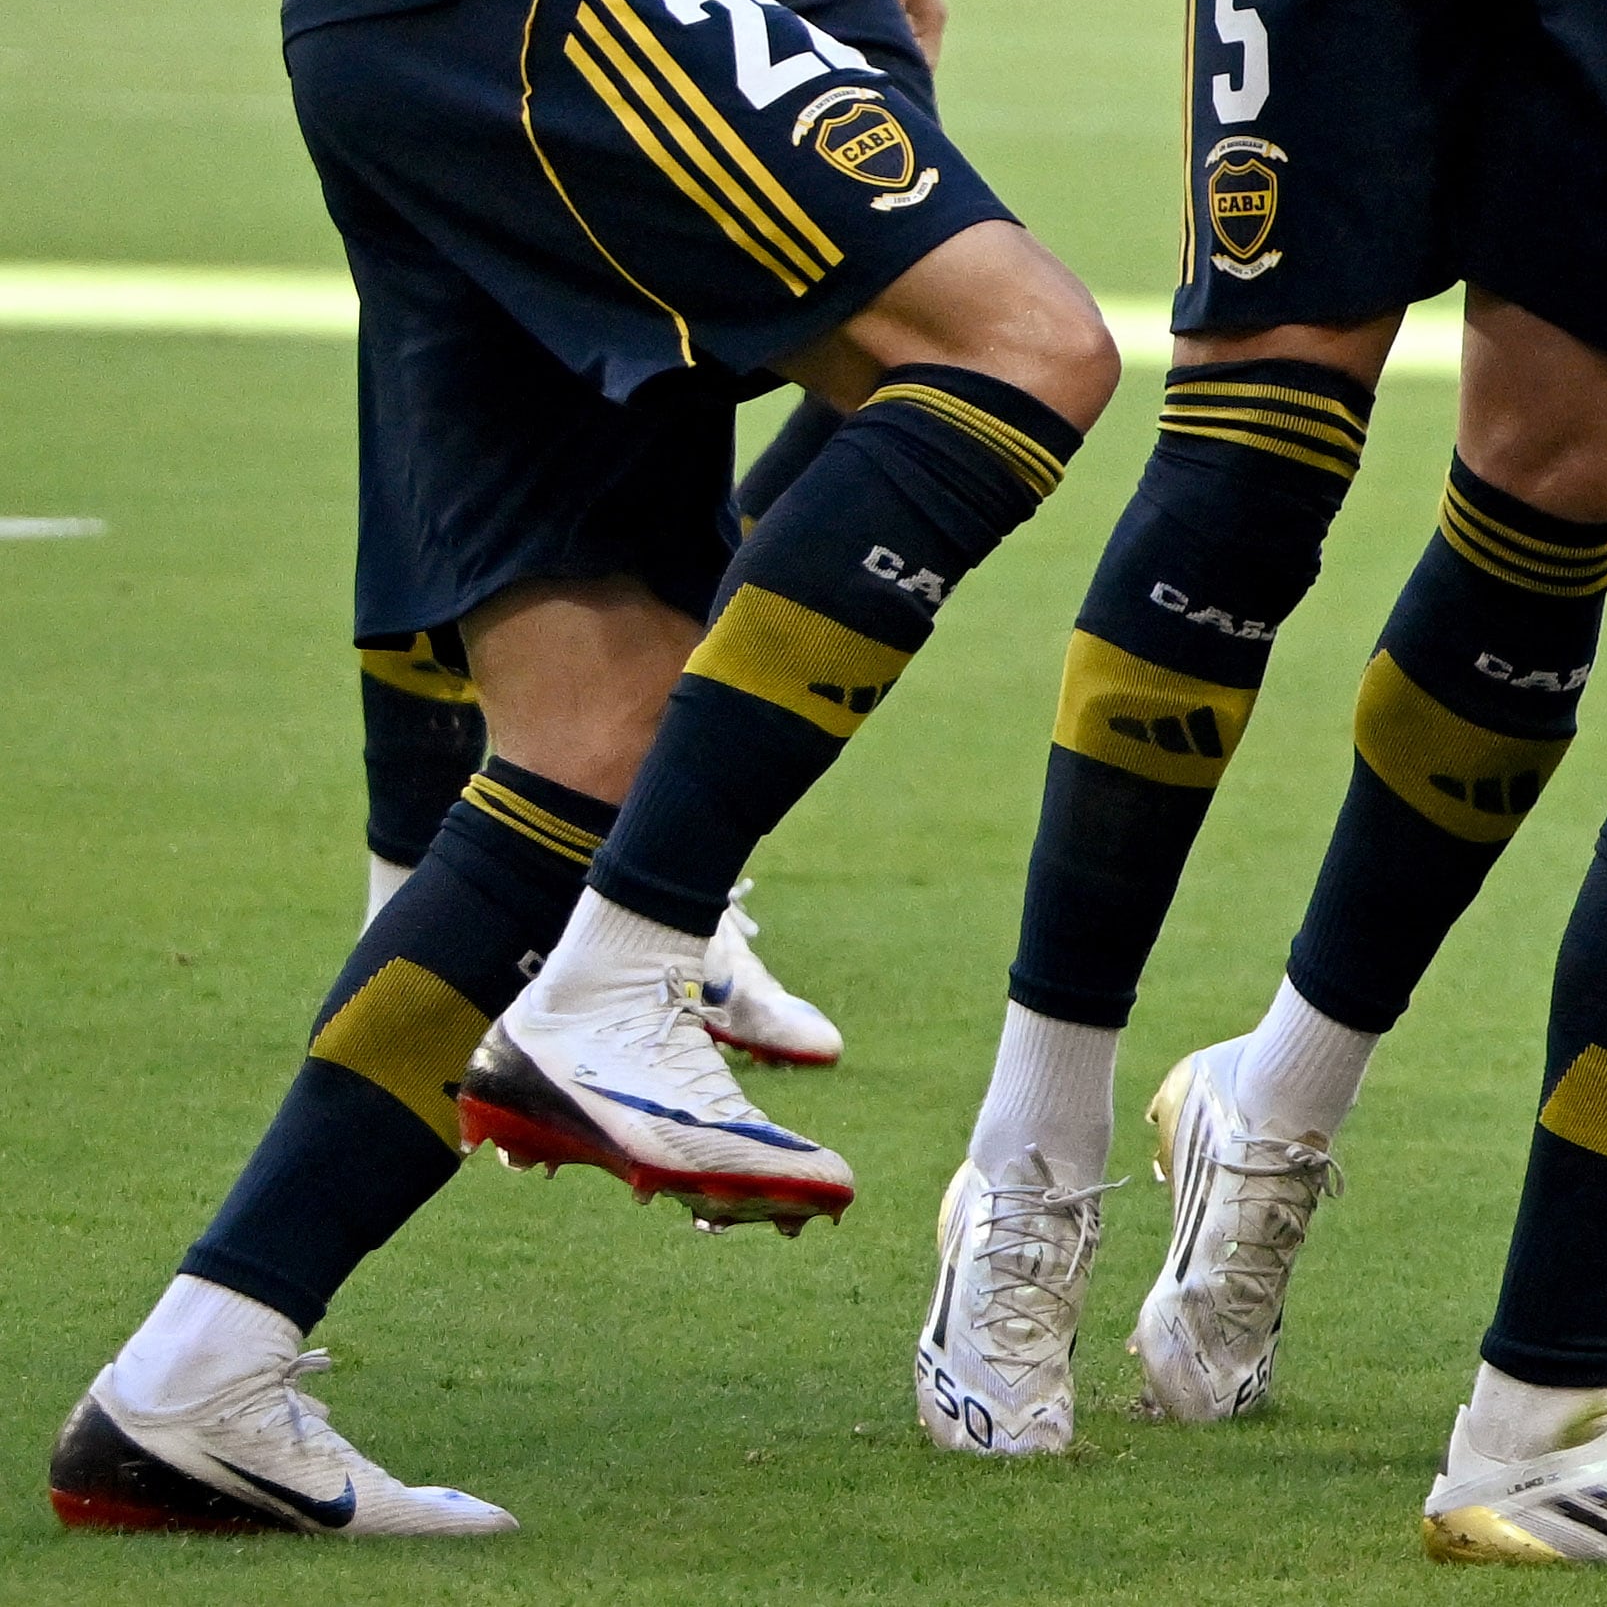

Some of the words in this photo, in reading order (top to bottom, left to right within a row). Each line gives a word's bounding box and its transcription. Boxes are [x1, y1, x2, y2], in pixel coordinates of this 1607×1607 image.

[841, 127, 895, 162] CABJ
[1218, 194, 1265, 213] CABJ
[862, 544, 956, 606] CA
[1474, 651, 1590, 692] CAB
